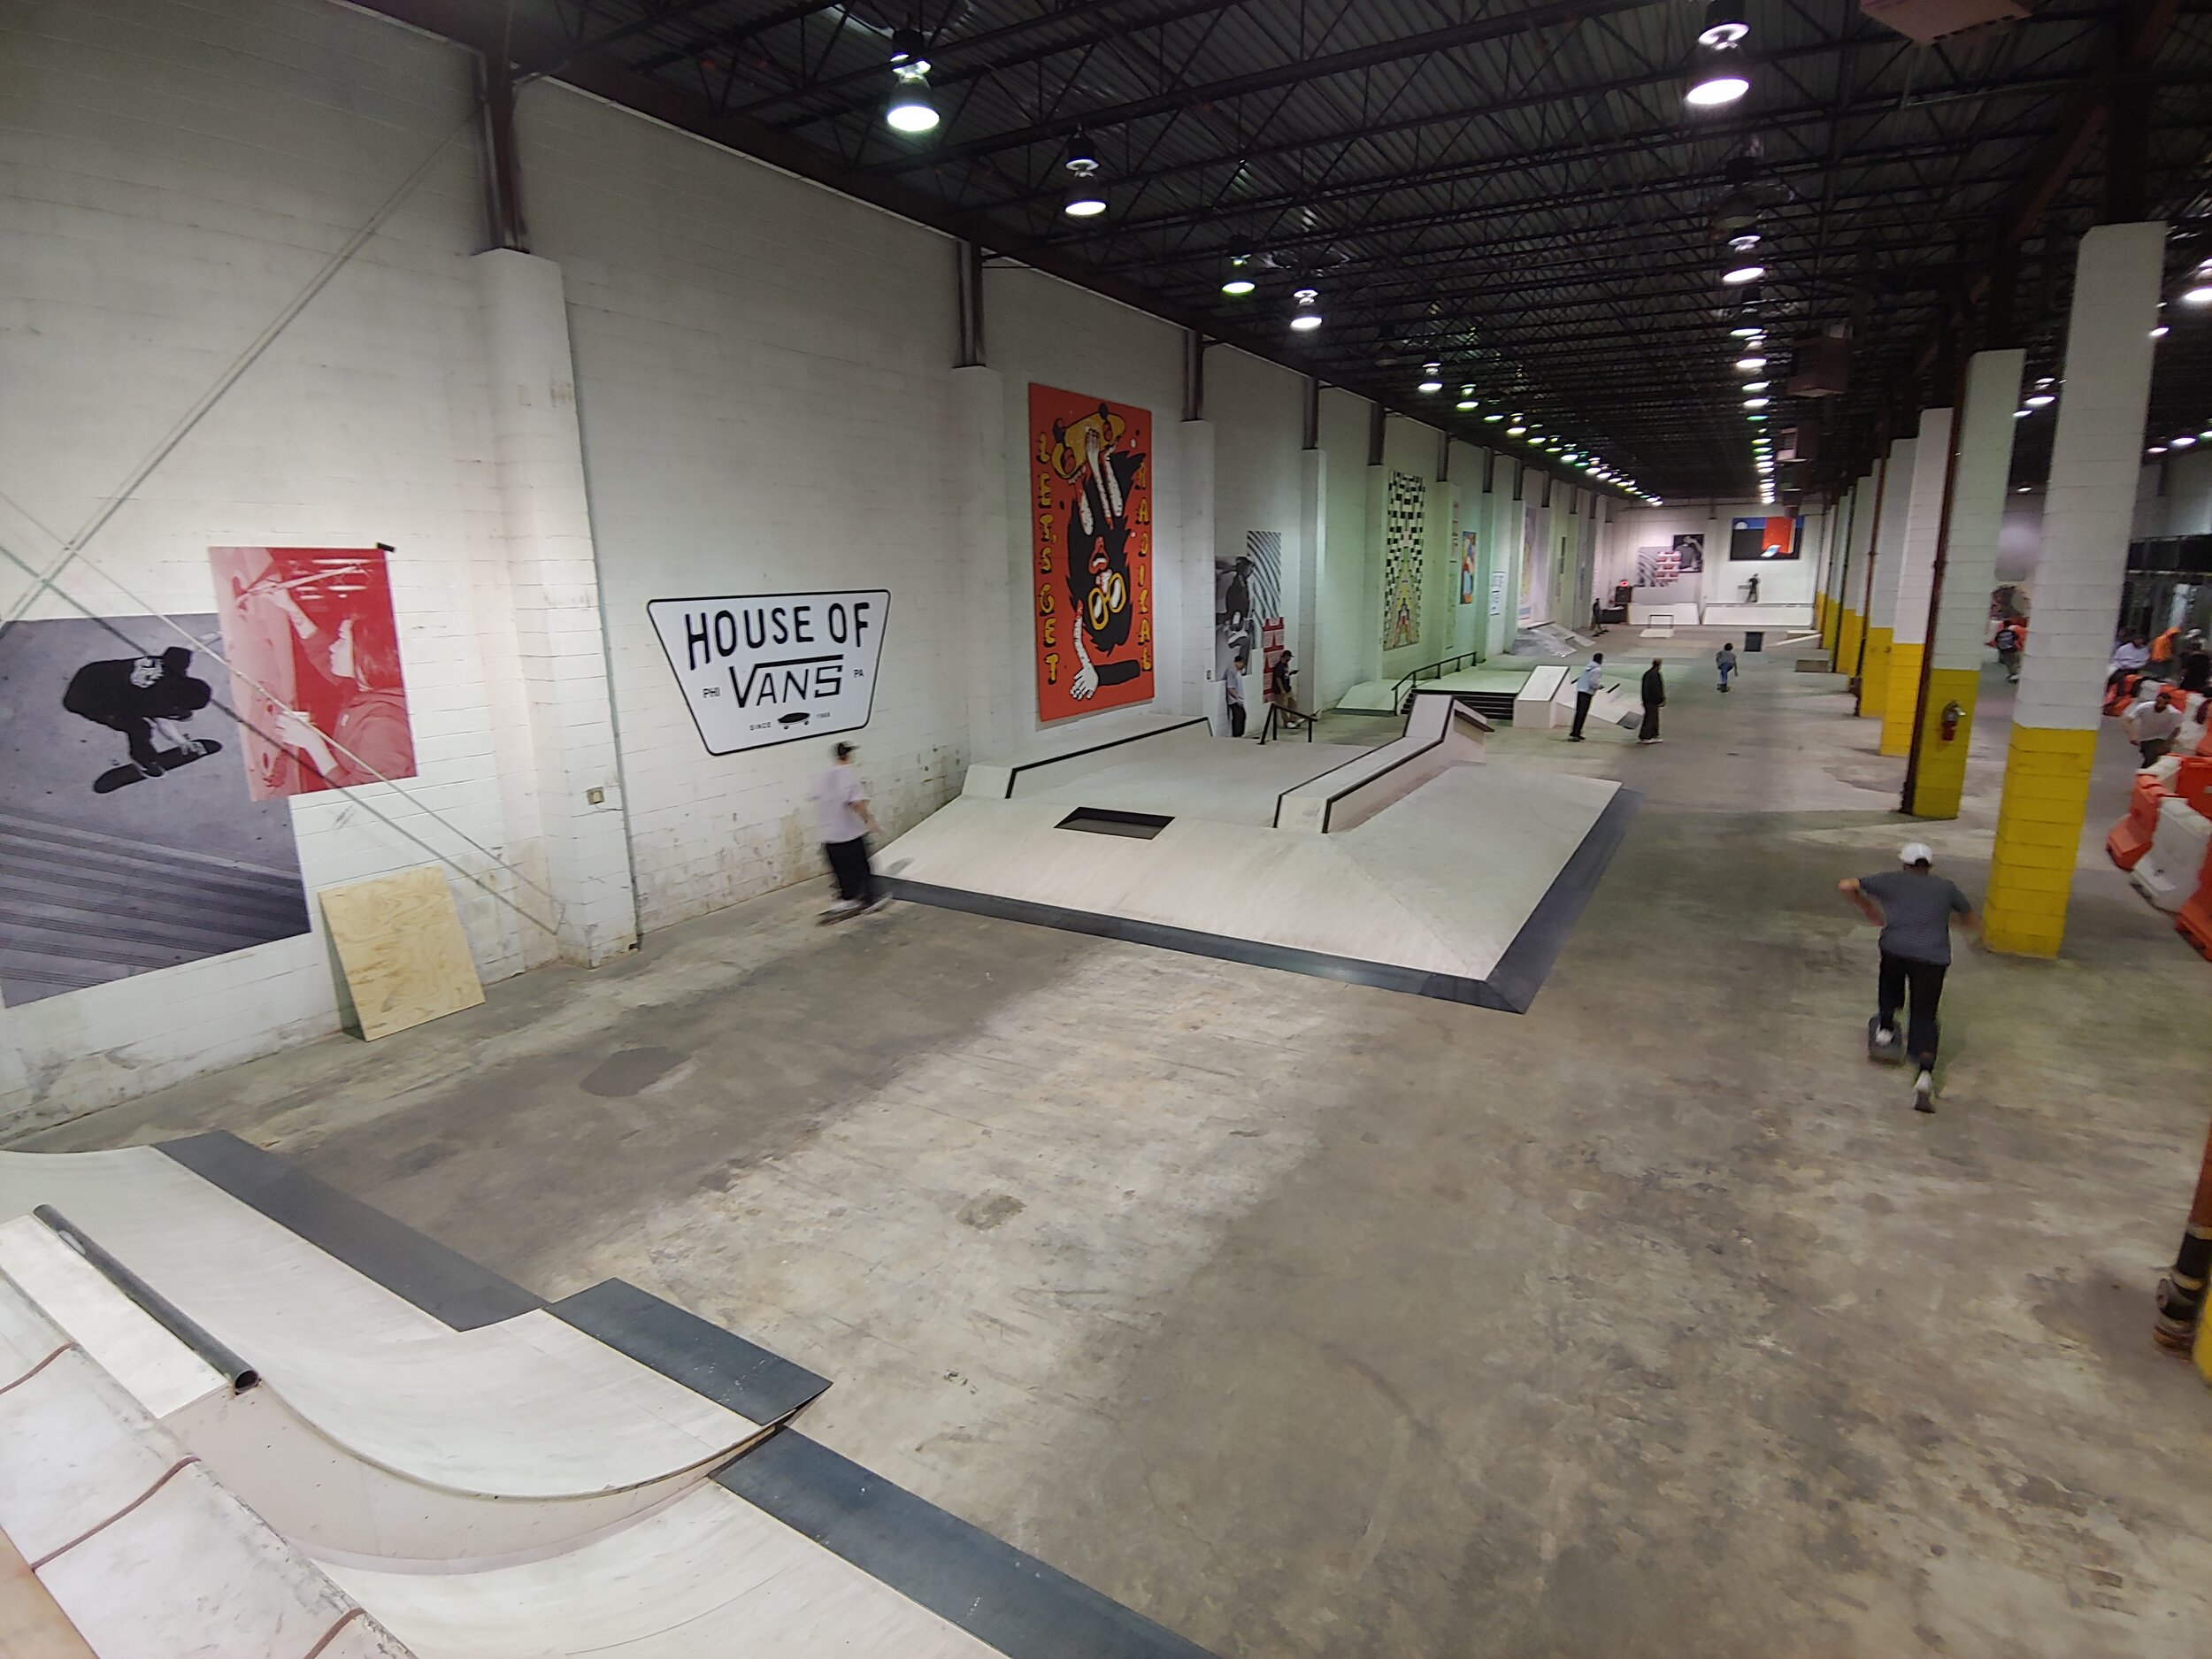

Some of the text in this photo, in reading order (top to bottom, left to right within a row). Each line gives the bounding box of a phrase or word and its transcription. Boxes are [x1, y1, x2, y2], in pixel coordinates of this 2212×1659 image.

[685, 602, 870, 671] HOUSE OF
[1039, 582, 1060, 685] GET
[729, 654, 844, 708] VANS
[853, 668, 864, 679] PA
